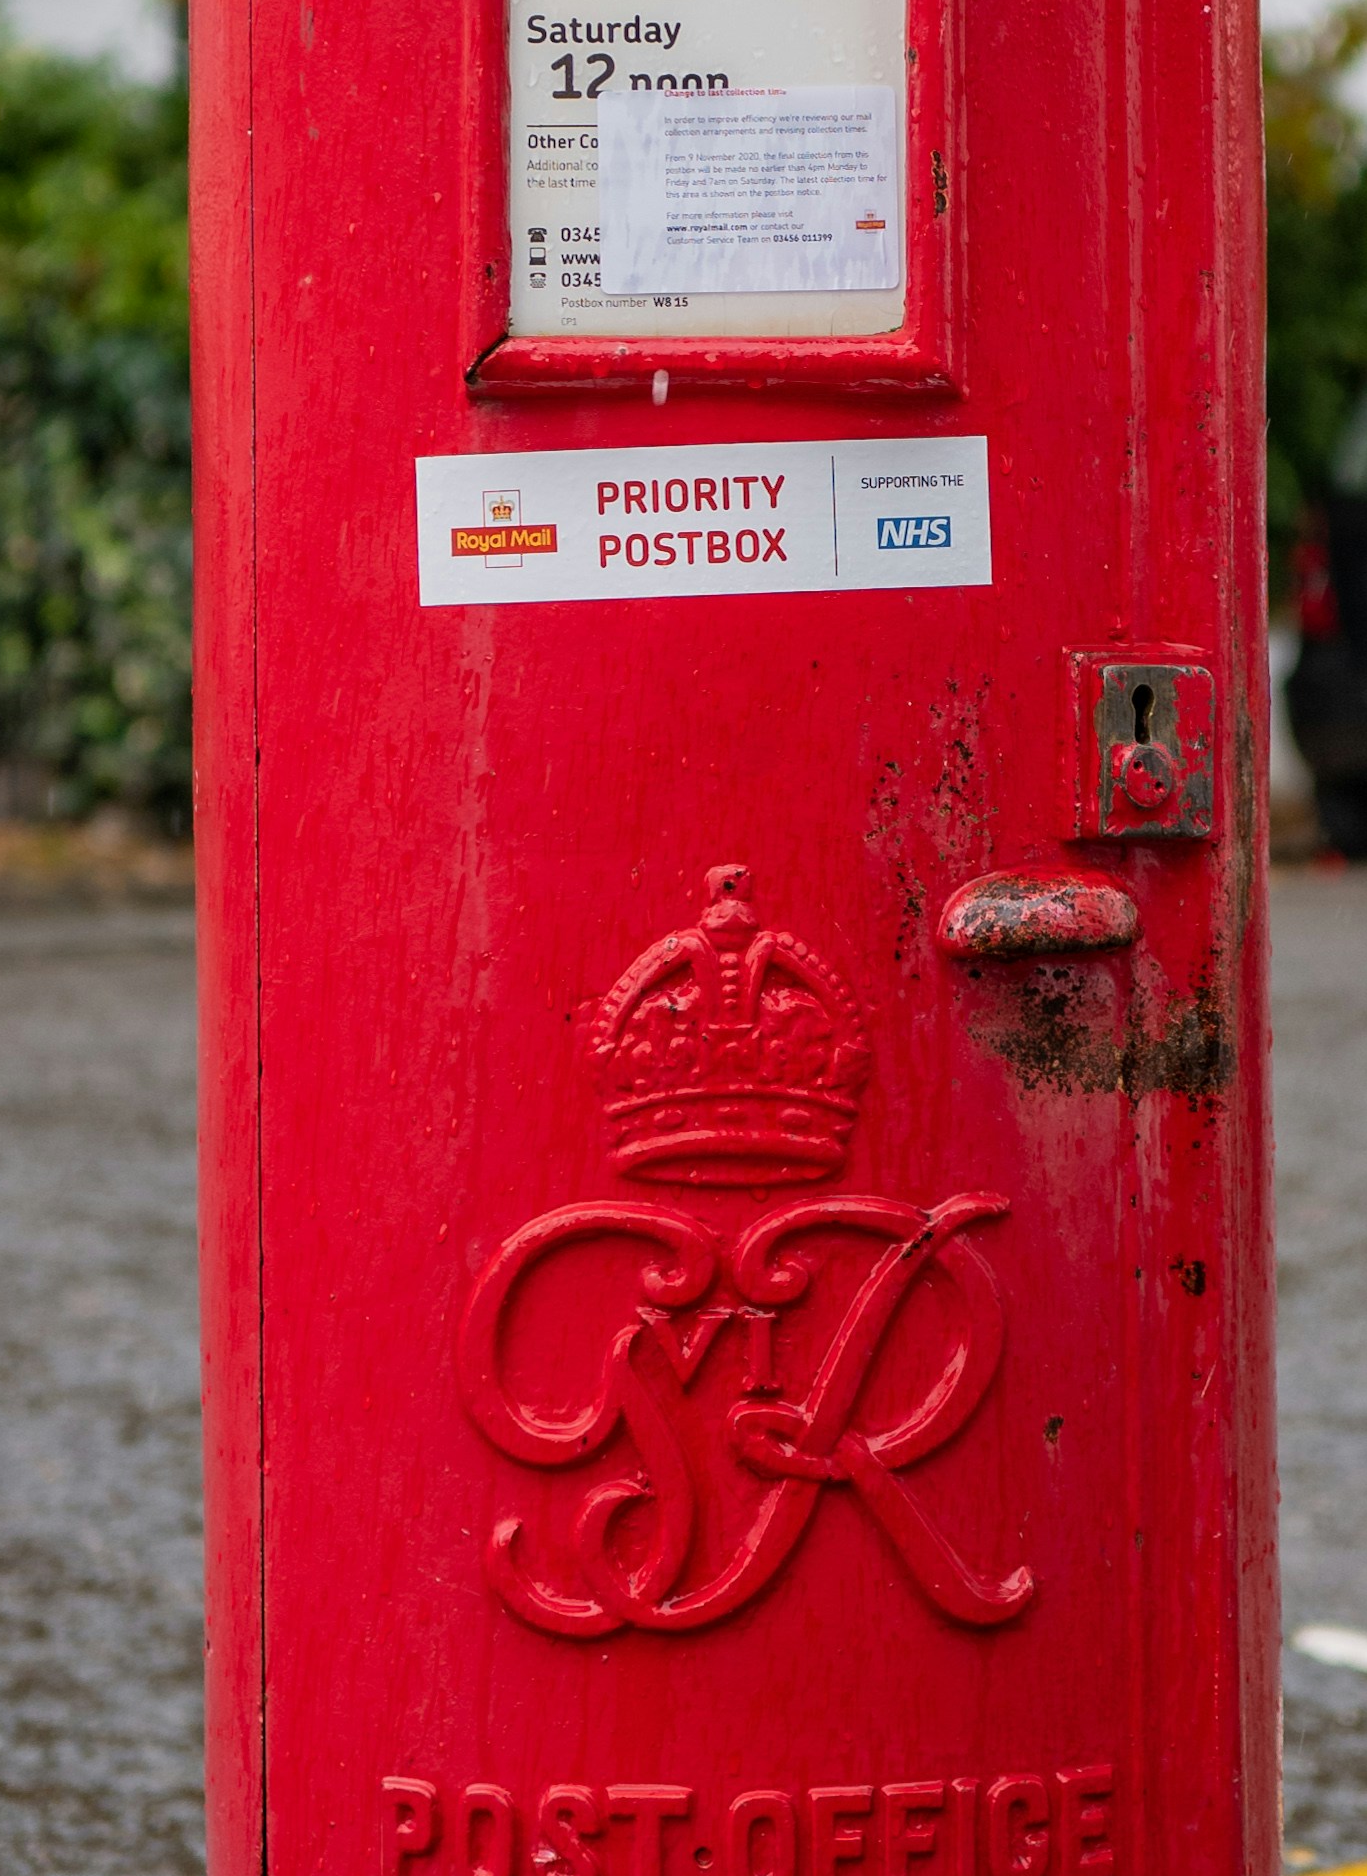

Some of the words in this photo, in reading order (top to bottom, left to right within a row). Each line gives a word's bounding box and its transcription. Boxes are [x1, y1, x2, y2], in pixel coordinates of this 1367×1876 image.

[527, 16, 681, 49] Saturday
[550, 53, 616, 99] 12
[664, 89, 695, 99] Change
[697, 89, 706, 97] to
[708, 88, 724, 97] last
[726, 88, 765, 96] collection
[664, 116, 673, 124] In
[674, 116, 695, 124] order
[697, 116, 706, 124] to
[708, 115, 739, 126] improve
[741, 114, 777, 125] efficiency
[802, 114, 838, 124] reviewing
[856, 113, 872, 121] mail
[664, 128, 701, 137] collection
[702, 127, 756, 137] arrangements
[758, 127, 774, 135] and
[776, 126, 805, 136] revising
[807, 126, 843, 134] collection
[528, 134, 575, 149] Other
[665, 154, 686, 163] From
[688, 153, 694, 162] 9
[696, 153, 736, 162] November
[763, 151, 776, 160] the
[778, 151, 795, 160] final
[797, 151, 832, 160] collection
[835, 150, 853, 159] from
[855, 150, 869, 159] this
[526, 160, 583, 171] Additional
[665, 166, 695, 175] postbox
[697, 165, 711, 173] will
[713, 165, 722, 173] be
[724, 165, 746, 173] made
[761, 165, 785, 173] earlier
[787, 164, 806, 172] than
[807, 164, 826, 173] 4pm
[828, 163, 857, 172] Monday
[859, 163, 868, 171] to
[527, 178, 546, 189] the
[548, 177, 569, 189] last
[570, 177, 597, 189] time
[665, 179, 689, 188] Friday
[692, 178, 707, 186] and
[709, 178, 727, 186] 7am
[780, 176, 794, 184] The
[796, 176, 818, 184] latest
[820, 175, 856, 184] collection
[876, 174, 887, 182] for
[666, 190, 680, 199] this
[710, 190, 734, 198] shown
[749, 189, 762, 197] the
[764, 189, 794, 199] postbox
[666, 212, 679, 220] For
[682, 212, 702, 220] more
[705, 211, 749, 219] information
[751, 210, 776, 220] please
[778, 210, 793, 218] visit
[667, 223, 748, 233] www.royalmail.com
[760, 223, 789, 231] contact
[667, 235, 705, 244] Customer
[706, 235, 734, 244] Service
[737, 234, 759, 243] Team
[773, 234, 800, 243] 03456
[561, 297, 603, 308] Postbox
[605, 297, 647, 308] number
[653, 297, 672, 308] W8
[674, 297, 689, 307] 15
[861, 475, 937, 489] SUPPORTING
[940, 474, 965, 487] THE
[597, 474, 786, 515] PRIORITY
[879, 518, 949, 548] NHS
[456, 529, 506, 553] Royal
[510, 527, 551, 548] Mail
[599, 528, 788, 568] POSTBOX
